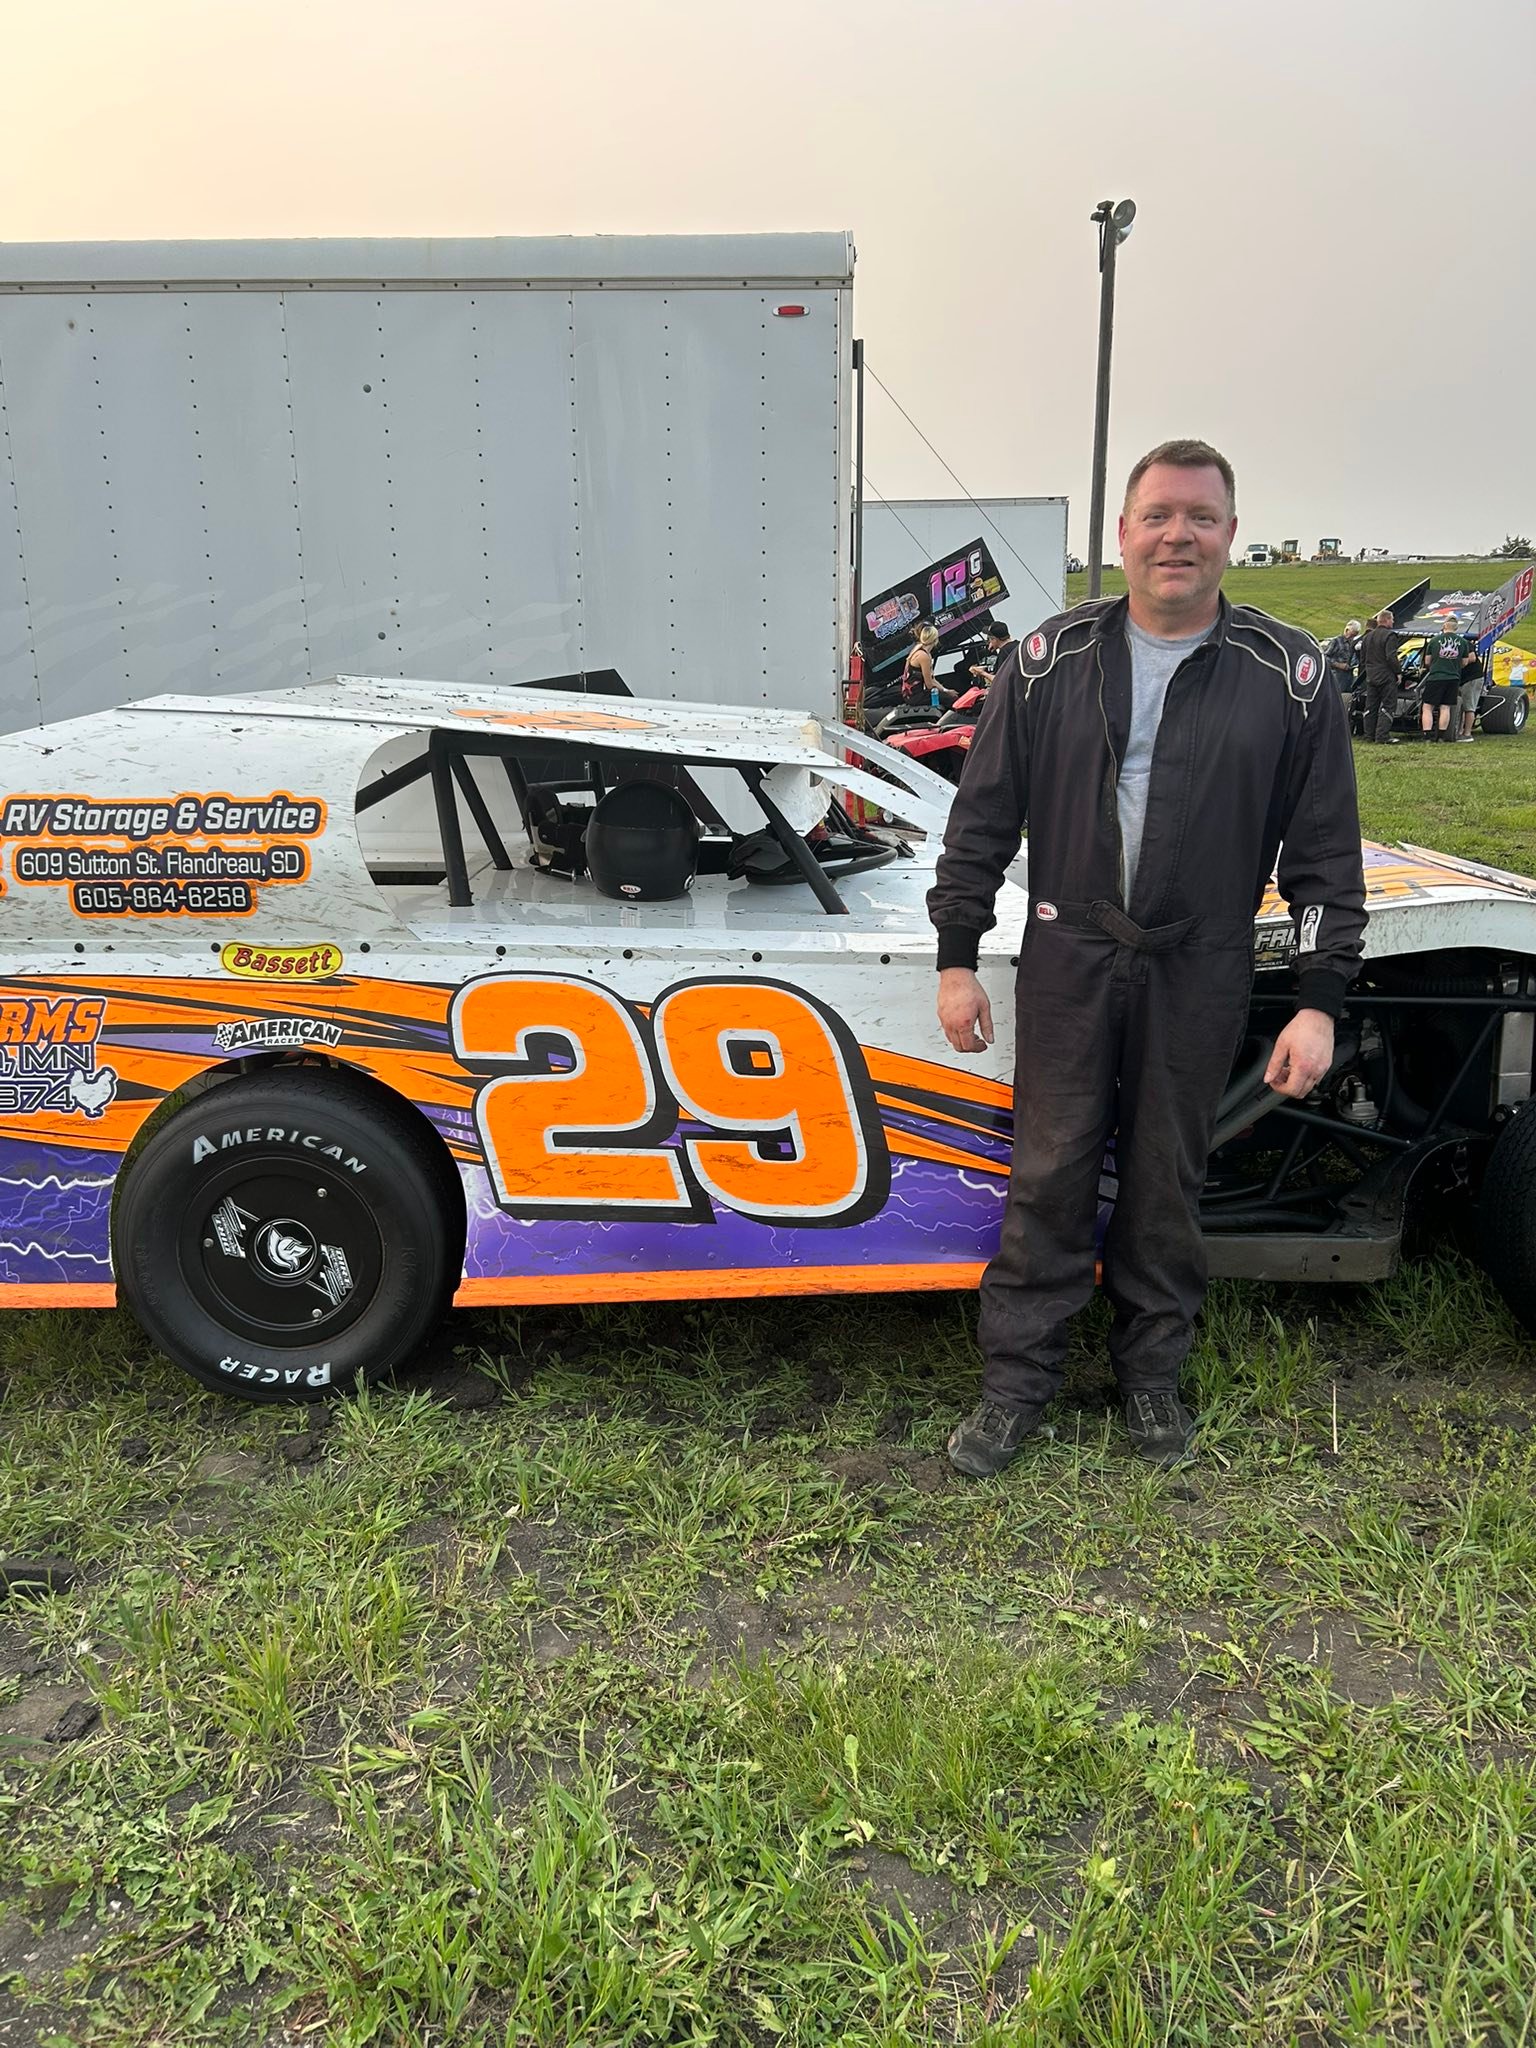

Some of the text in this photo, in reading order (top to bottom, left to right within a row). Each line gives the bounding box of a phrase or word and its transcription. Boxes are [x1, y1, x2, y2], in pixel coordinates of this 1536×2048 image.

[930, 560, 967, 613] 12
[970, 551, 982, 575] G
[1515, 567, 1534, 608] 18
[1032, 636, 1041, 657] BELL
[1300, 659, 1312, 681] BELL
[5, 801, 316, 836] RV Storage & Service
[21, 850, 300, 877] 609 Sutton St. Flandreau, SD
[78, 886, 247, 910] 605-864-6258
[1038, 906, 1054, 916] BELL
[233, 947, 333, 975] Bassett
[228, 1020, 340, 1047] AMERICAN
[266, 1037, 301, 1045] RACER
[23, 1044, 93, 1071] MN
[453, 973, 868, 1219] 29
[192, 1128, 369, 1174] AMERICAN
[218, 1356, 332, 1387] RACER
